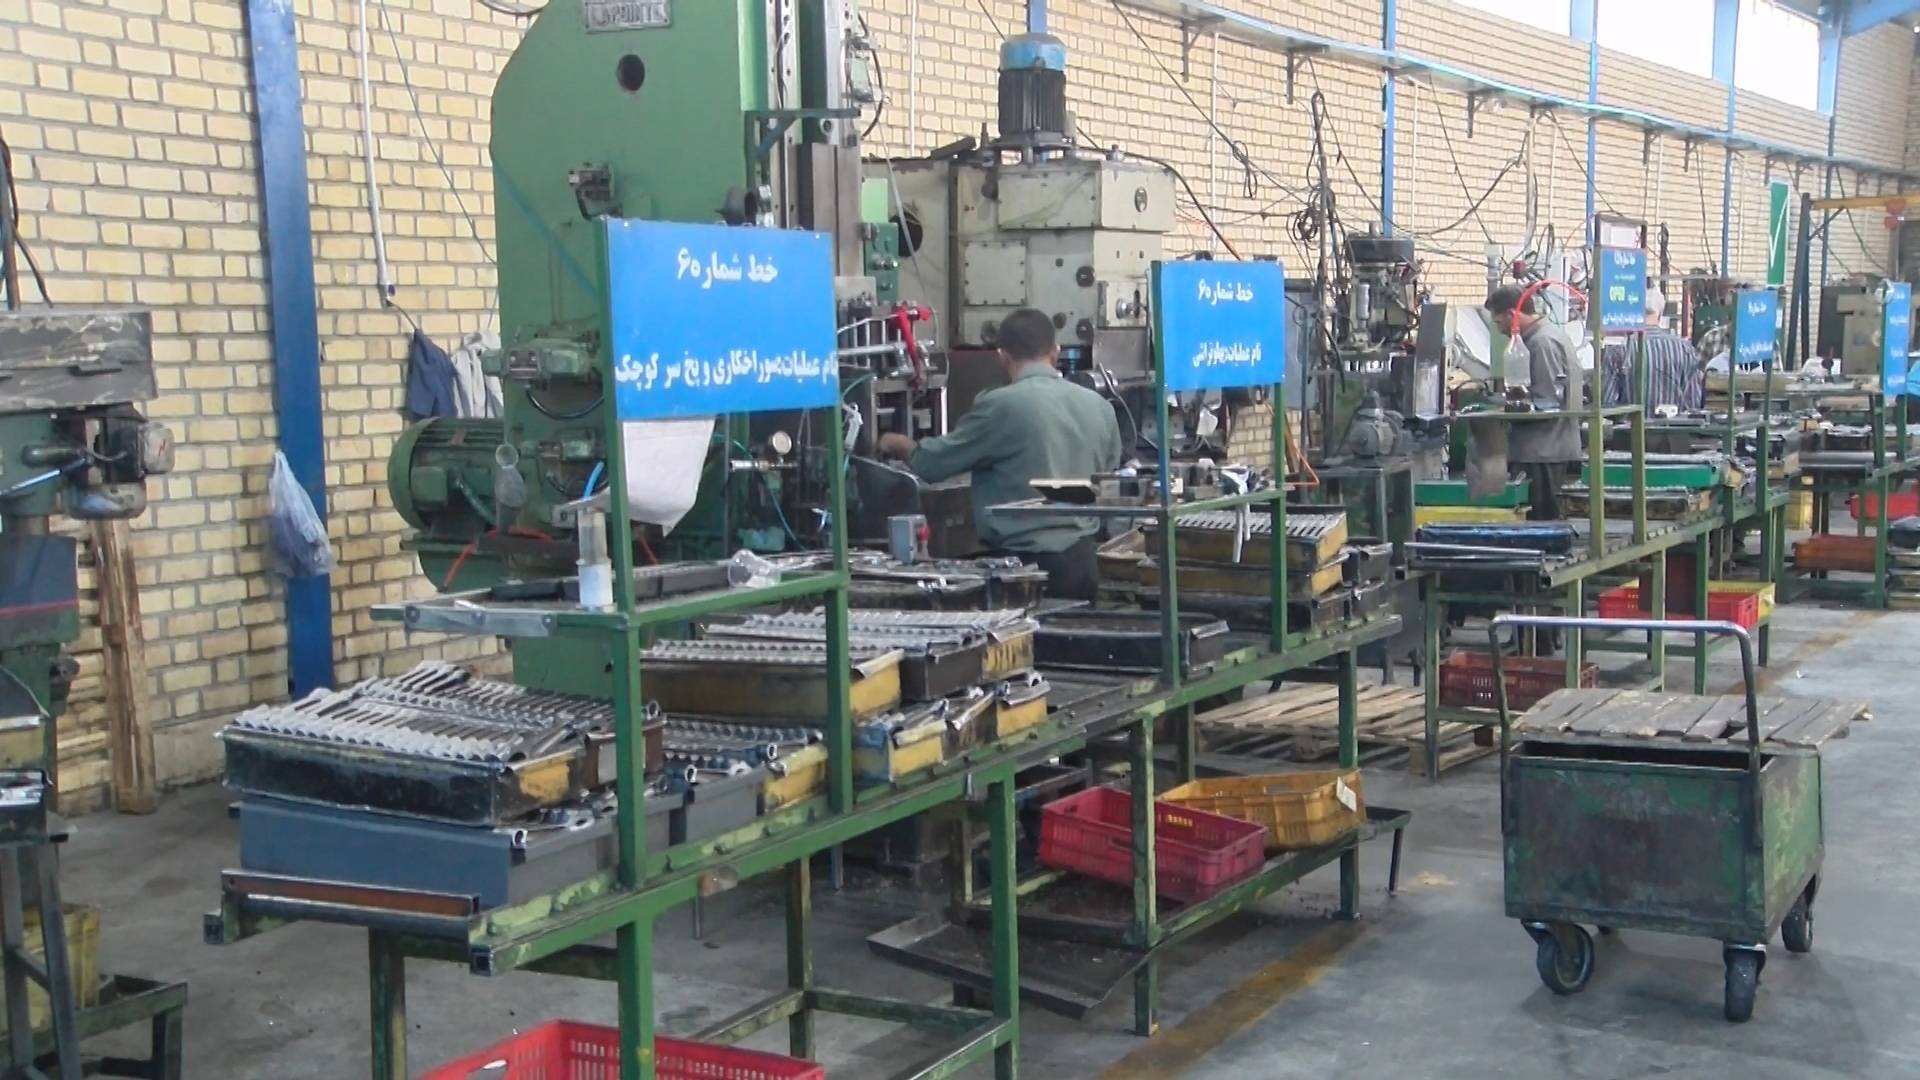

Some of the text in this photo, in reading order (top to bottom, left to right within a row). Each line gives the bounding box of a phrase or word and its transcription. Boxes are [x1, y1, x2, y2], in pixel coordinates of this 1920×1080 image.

[747, 253, 779, 283] خط
[1236, 281, 1254, 302] خط
[614, 352, 660, 391] کوچک
[663, 361, 681, 389] سر
